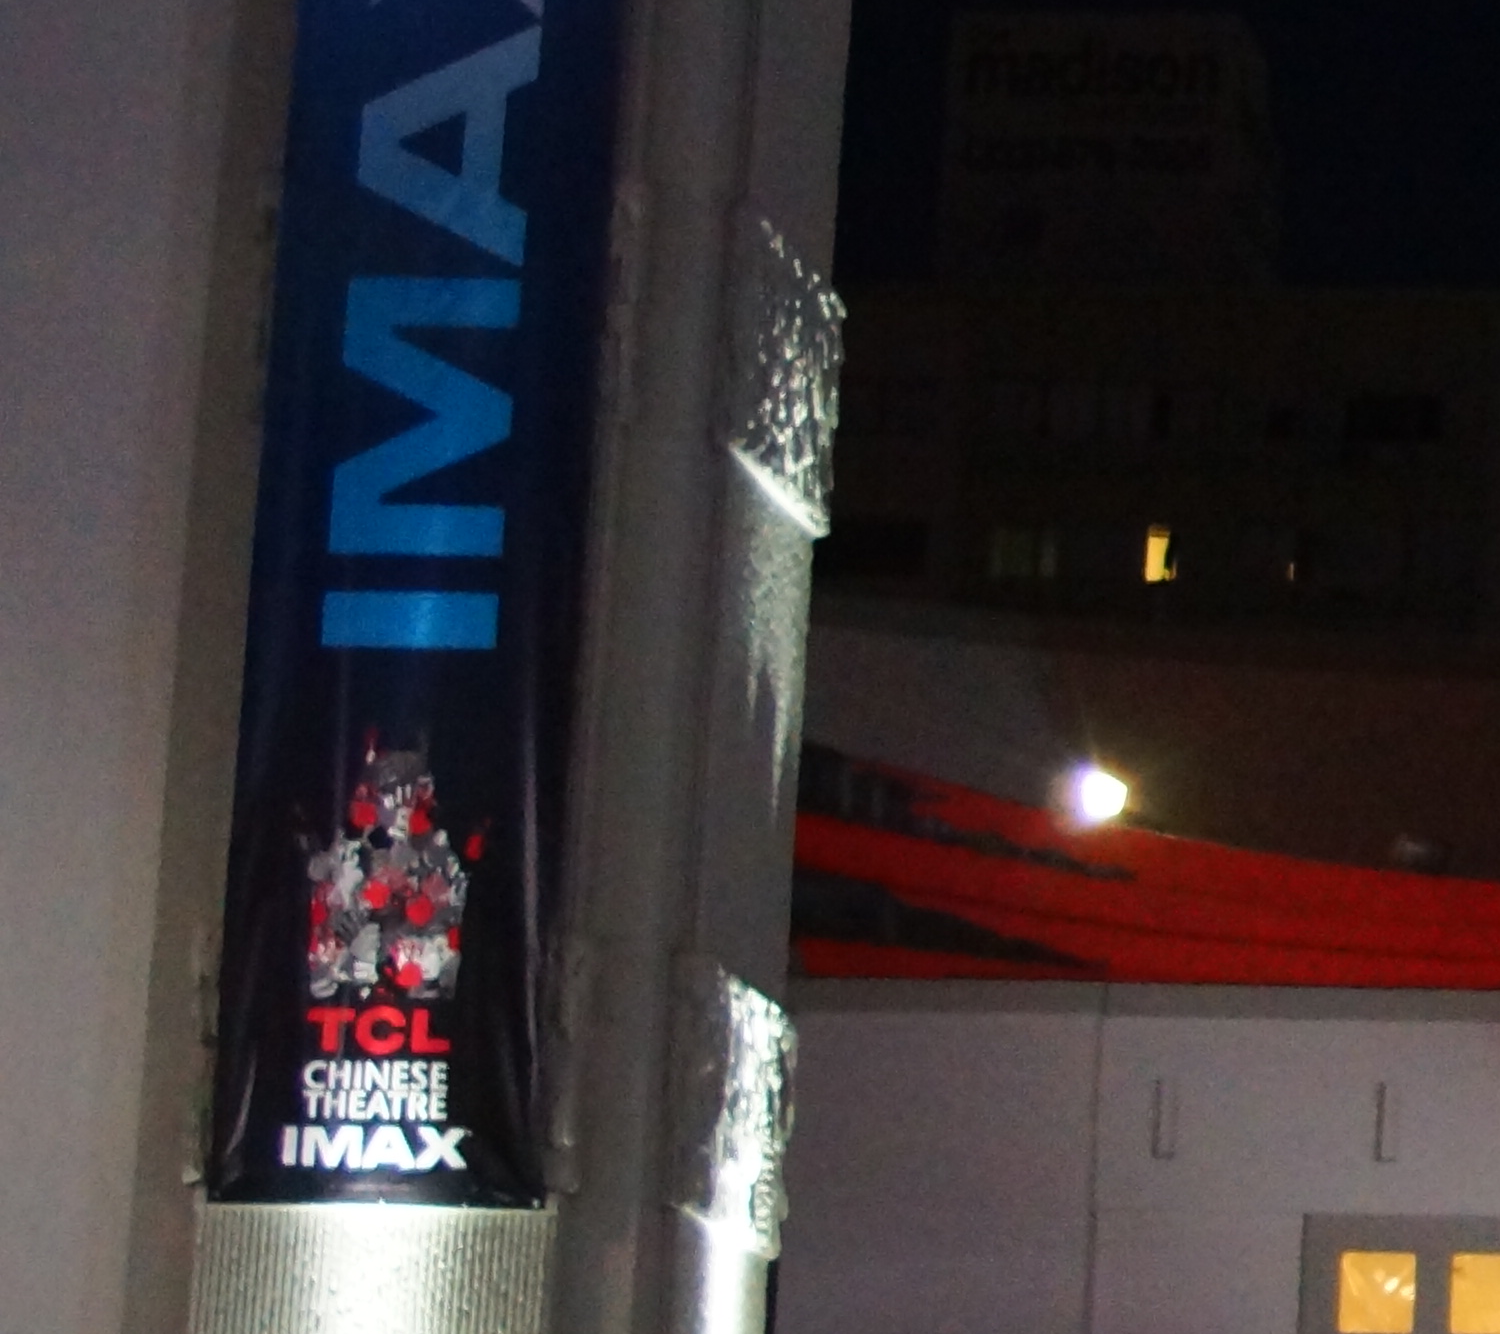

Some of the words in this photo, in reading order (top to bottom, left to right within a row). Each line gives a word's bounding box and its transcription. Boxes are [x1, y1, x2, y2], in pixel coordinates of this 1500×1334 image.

[307, 1004, 451, 1055] TCL
[303, 1059, 449, 1091] CHINESE
[303, 1089, 449, 1121] THEATRE
[281, 1124, 470, 1172] IMAX
